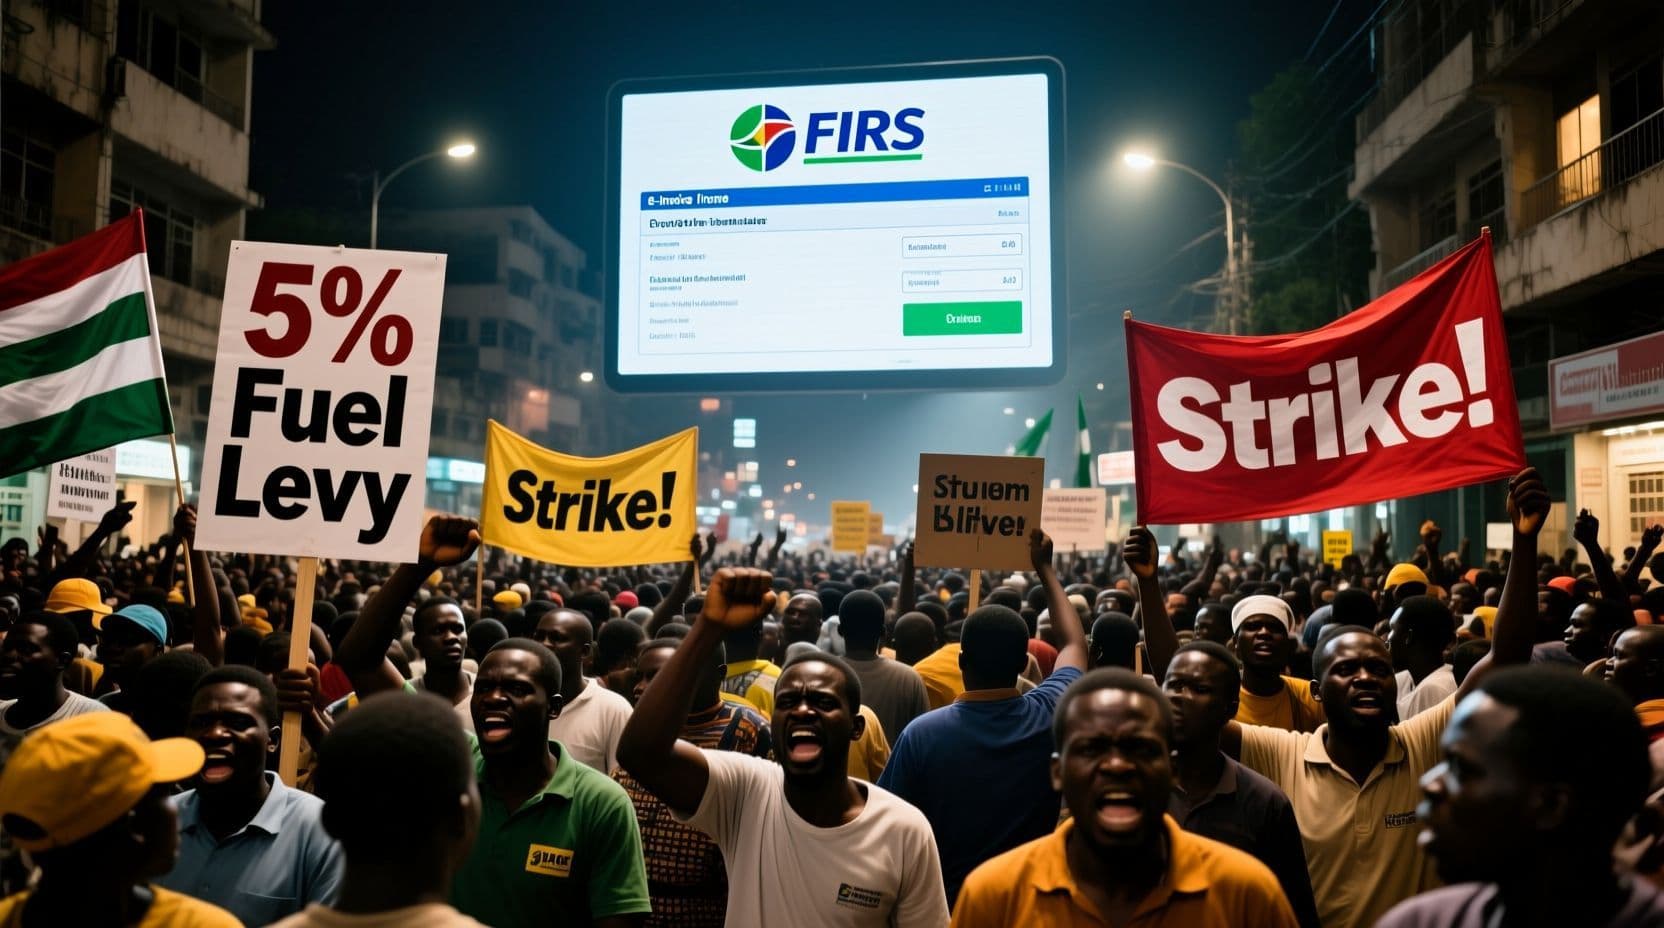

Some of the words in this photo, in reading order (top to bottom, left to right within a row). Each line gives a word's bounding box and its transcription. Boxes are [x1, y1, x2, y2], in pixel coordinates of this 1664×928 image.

[805, 107, 925, 154] FIRS
[244, 262, 414, 366] 5%
[230, 367, 408, 447] Fuel
[1157, 317, 1494, 472] Strike!
[215, 444, 412, 545] Levy
[503, 469, 677, 532] Strike!
